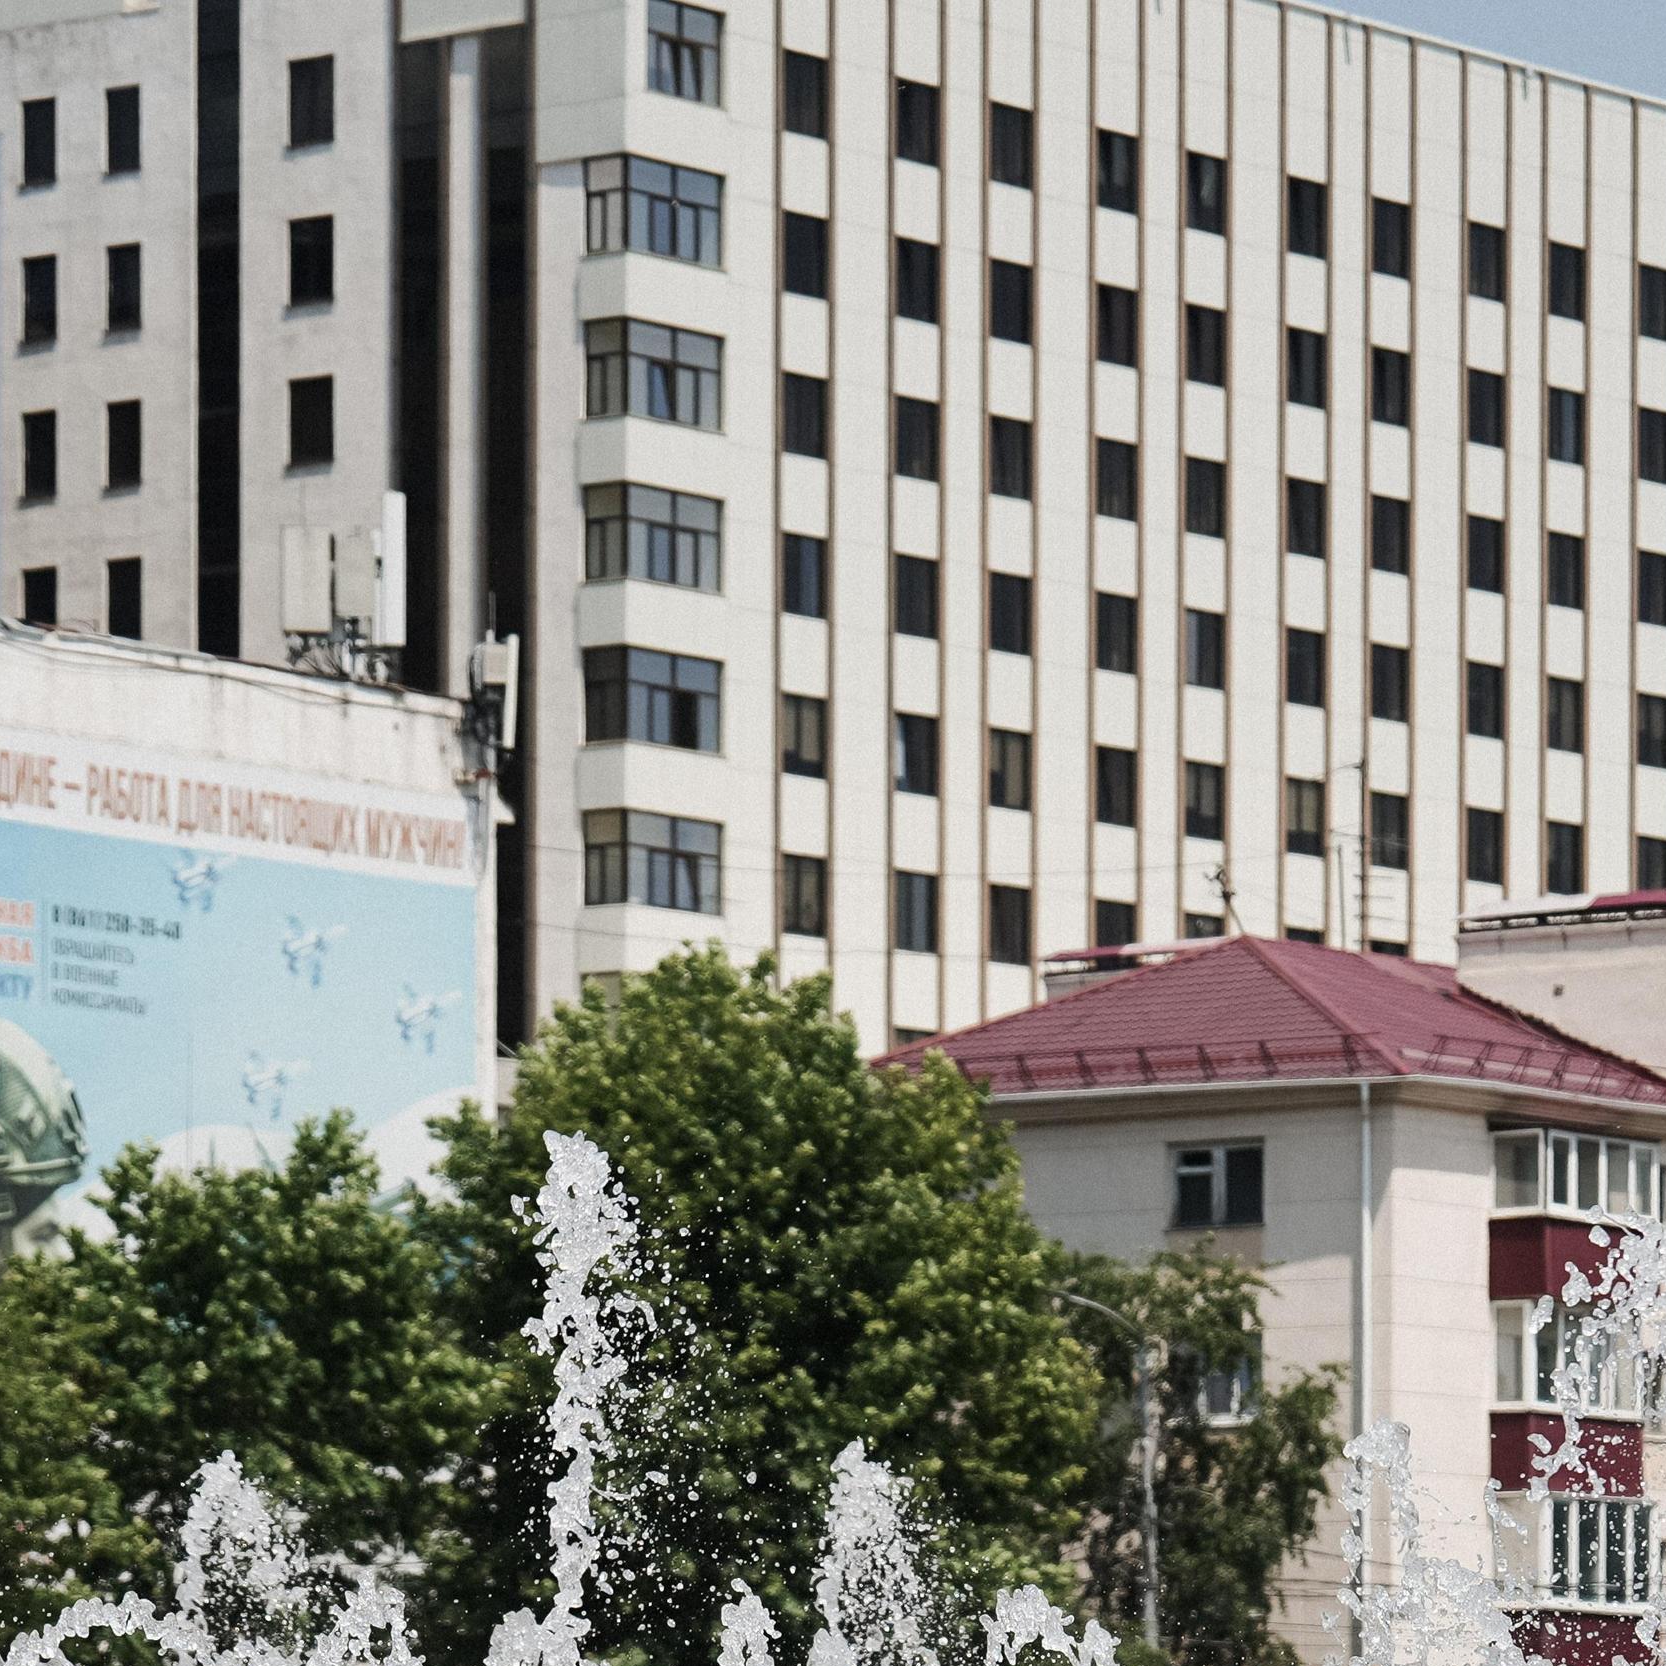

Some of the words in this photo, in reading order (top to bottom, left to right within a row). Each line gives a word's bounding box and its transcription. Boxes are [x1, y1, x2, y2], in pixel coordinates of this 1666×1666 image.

[87, 762, 170, 827] РАБОТА
[175, 777, 223, 836] ДЛЯ
[228, 785, 360, 856] НАСТОЯЩИХ
